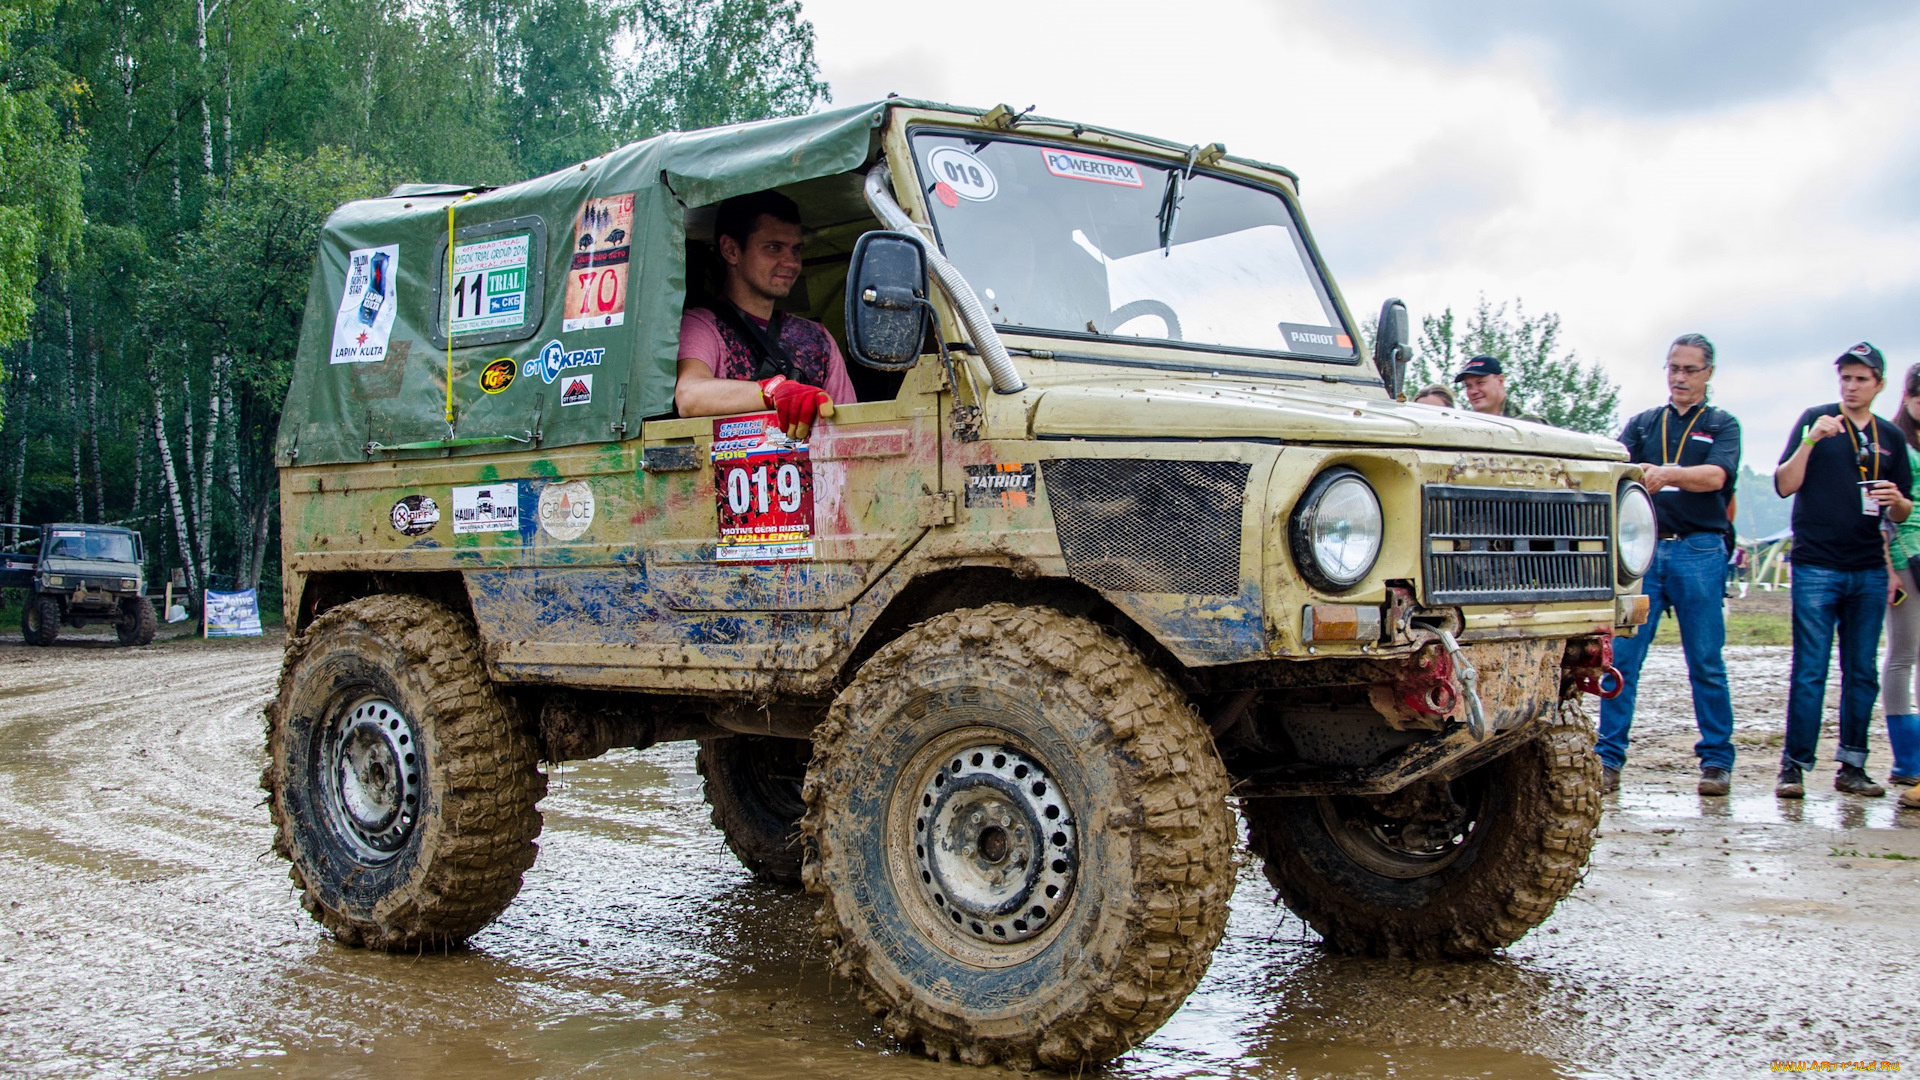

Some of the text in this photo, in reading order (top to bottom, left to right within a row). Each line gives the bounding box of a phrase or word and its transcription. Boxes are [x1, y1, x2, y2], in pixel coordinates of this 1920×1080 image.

[1048, 154, 1135, 179] POWERTRAX
[943, 161, 985, 188] 019
[500, 238, 520, 246] TRIAL
[489, 271, 520, 292] TRIAL
[348, 285, 362, 295] STAR
[454, 273, 483, 318] 11
[579, 269, 618, 314] 70
[501, 296, 520, 307] СКБ
[1291, 331, 1334, 345] PATRIOT
[335, 347, 358, 358] LAPIN
[359, 346, 383, 356] KULTA
[715, 438, 760, 450] RACE
[715, 450, 747, 460] 2016
[969, 474, 1032, 489] PATRIOT
[728, 464, 801, 514] 019
[496, 506, 518, 518] ЛЮДИ
[722, 524, 810, 535] MOTIVE GEAR RUSSIA
[222, 594, 254, 606] Motive
[229, 607, 253, 619] Gear
